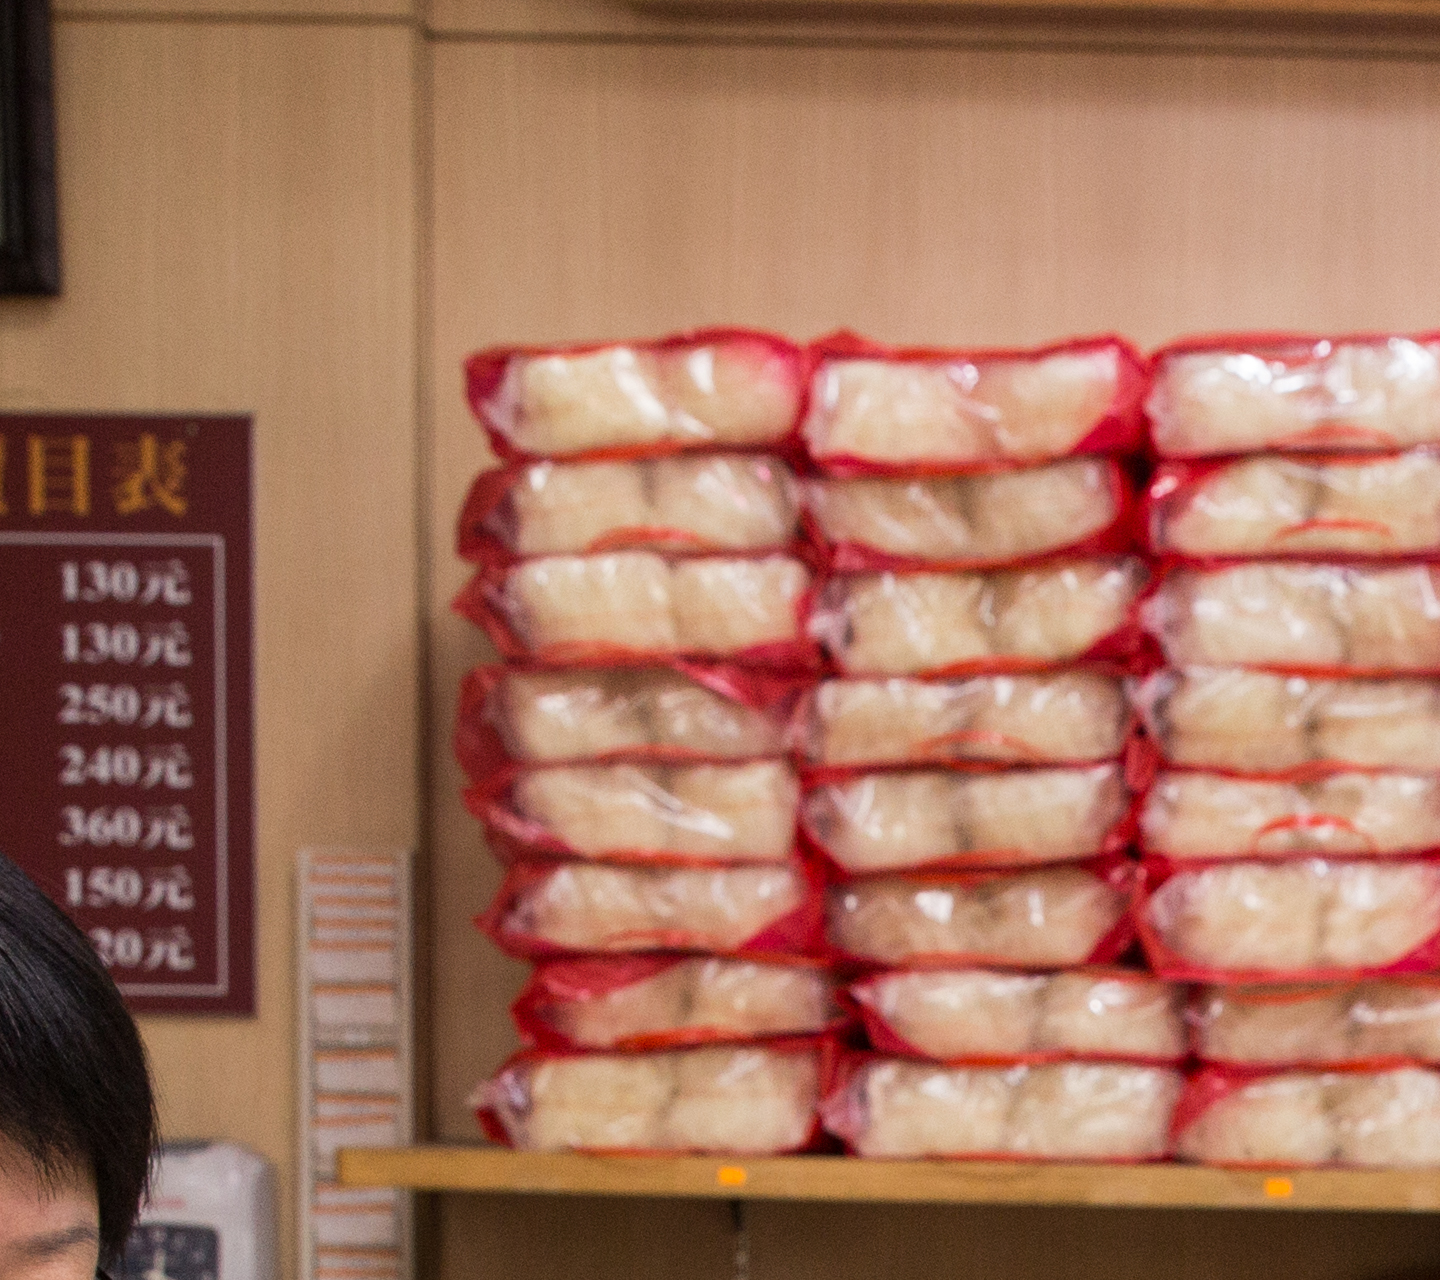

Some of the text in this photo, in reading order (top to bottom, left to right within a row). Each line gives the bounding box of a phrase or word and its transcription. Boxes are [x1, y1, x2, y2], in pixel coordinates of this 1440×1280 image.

[59, 559, 194, 605] 130元
[59, 621, 194, 666] 130元
[59, 683, 194, 729] 250元
[59, 744, 195, 790] 240元
[59, 805, 195, 852] 360元
[60, 867, 196, 912] 150元
[93, 927, 196, 974] 20元
